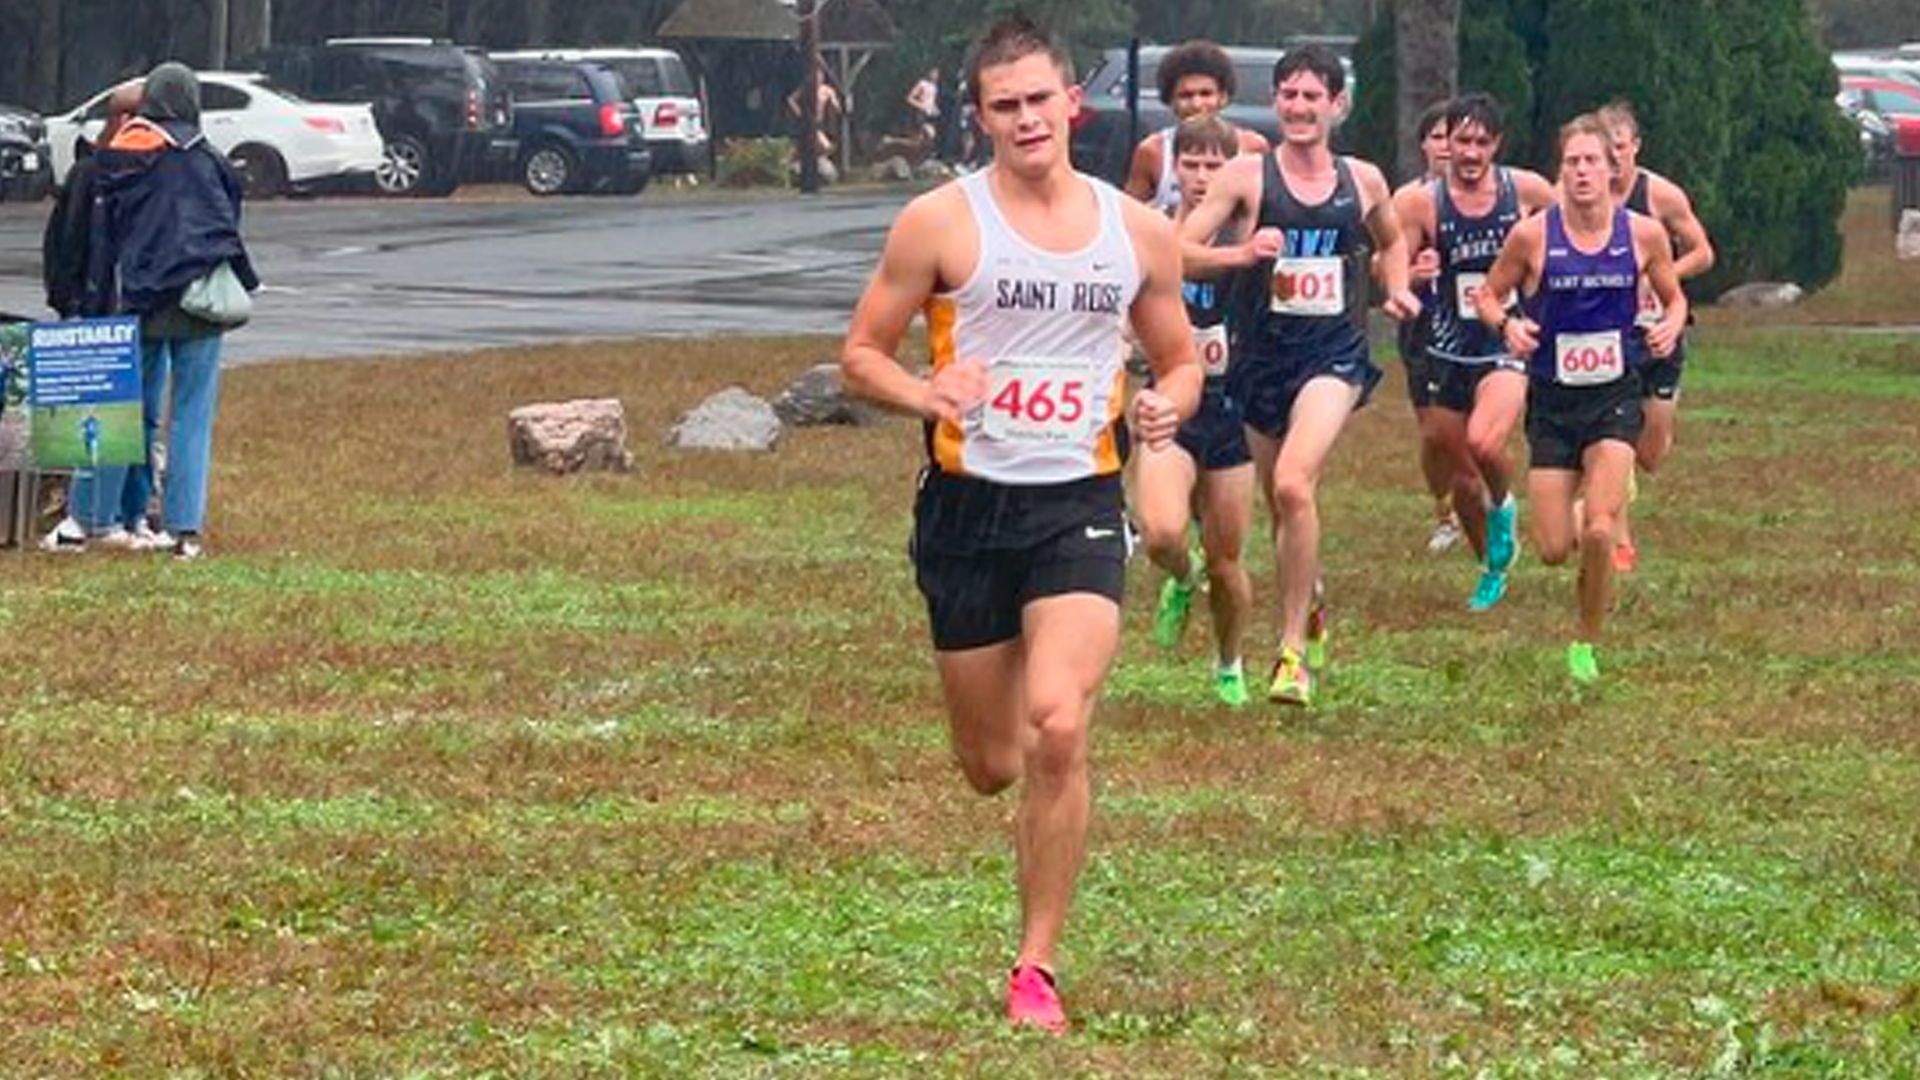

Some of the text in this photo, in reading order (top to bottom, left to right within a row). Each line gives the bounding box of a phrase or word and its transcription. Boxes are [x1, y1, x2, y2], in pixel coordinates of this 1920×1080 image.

[996, 279, 1122, 316] SAINT ROSE
[1562, 346, 1617, 372] 604
[991, 379, 1084, 423] 465
